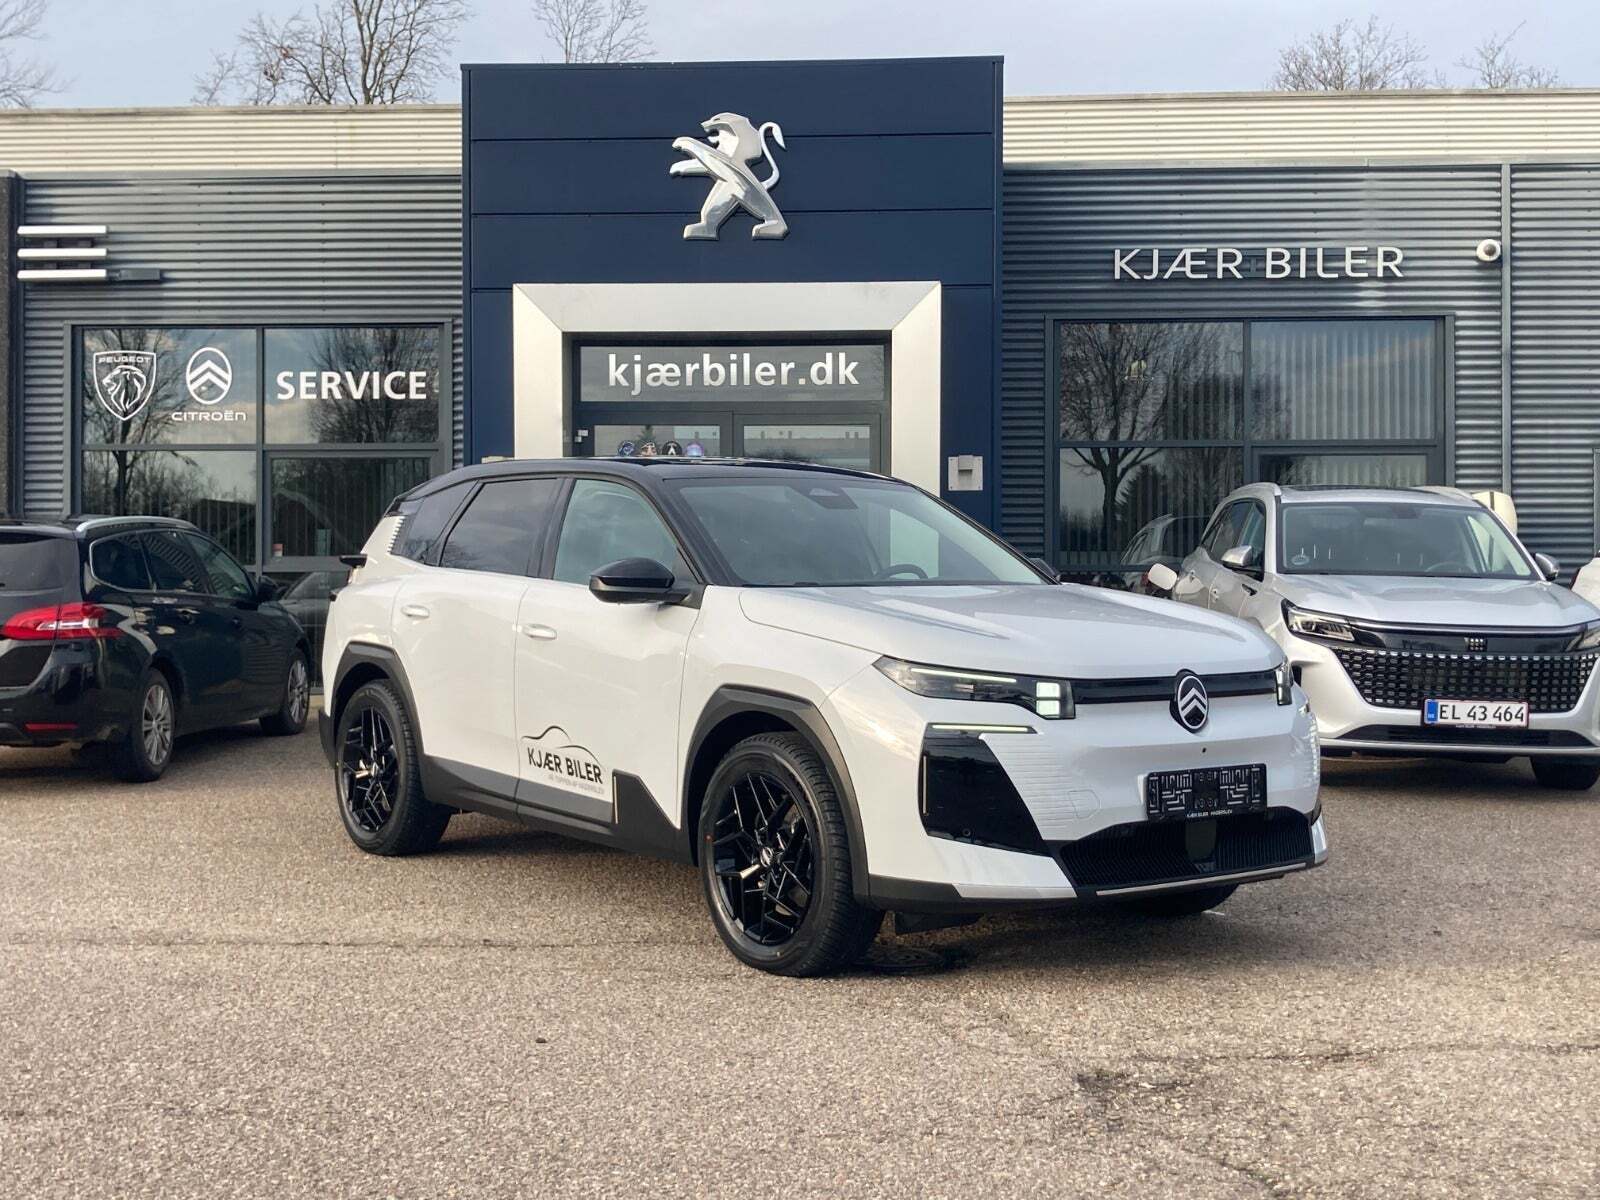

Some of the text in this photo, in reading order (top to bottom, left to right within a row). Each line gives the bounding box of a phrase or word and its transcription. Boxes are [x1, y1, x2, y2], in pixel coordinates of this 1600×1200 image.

[1113, 246, 1404, 280] KJÆR BILER
[98, 356, 151, 364] PEUGEOT
[608, 351, 860, 396] kjærbiler.dk
[276, 370, 427, 401] SERVICE
[171, 410, 246, 421] CITROËN
[1439, 704, 1524, 722] EL 43 464
[527, 747, 562, 774] KJÆR
[565, 757, 603, 785] BILER
